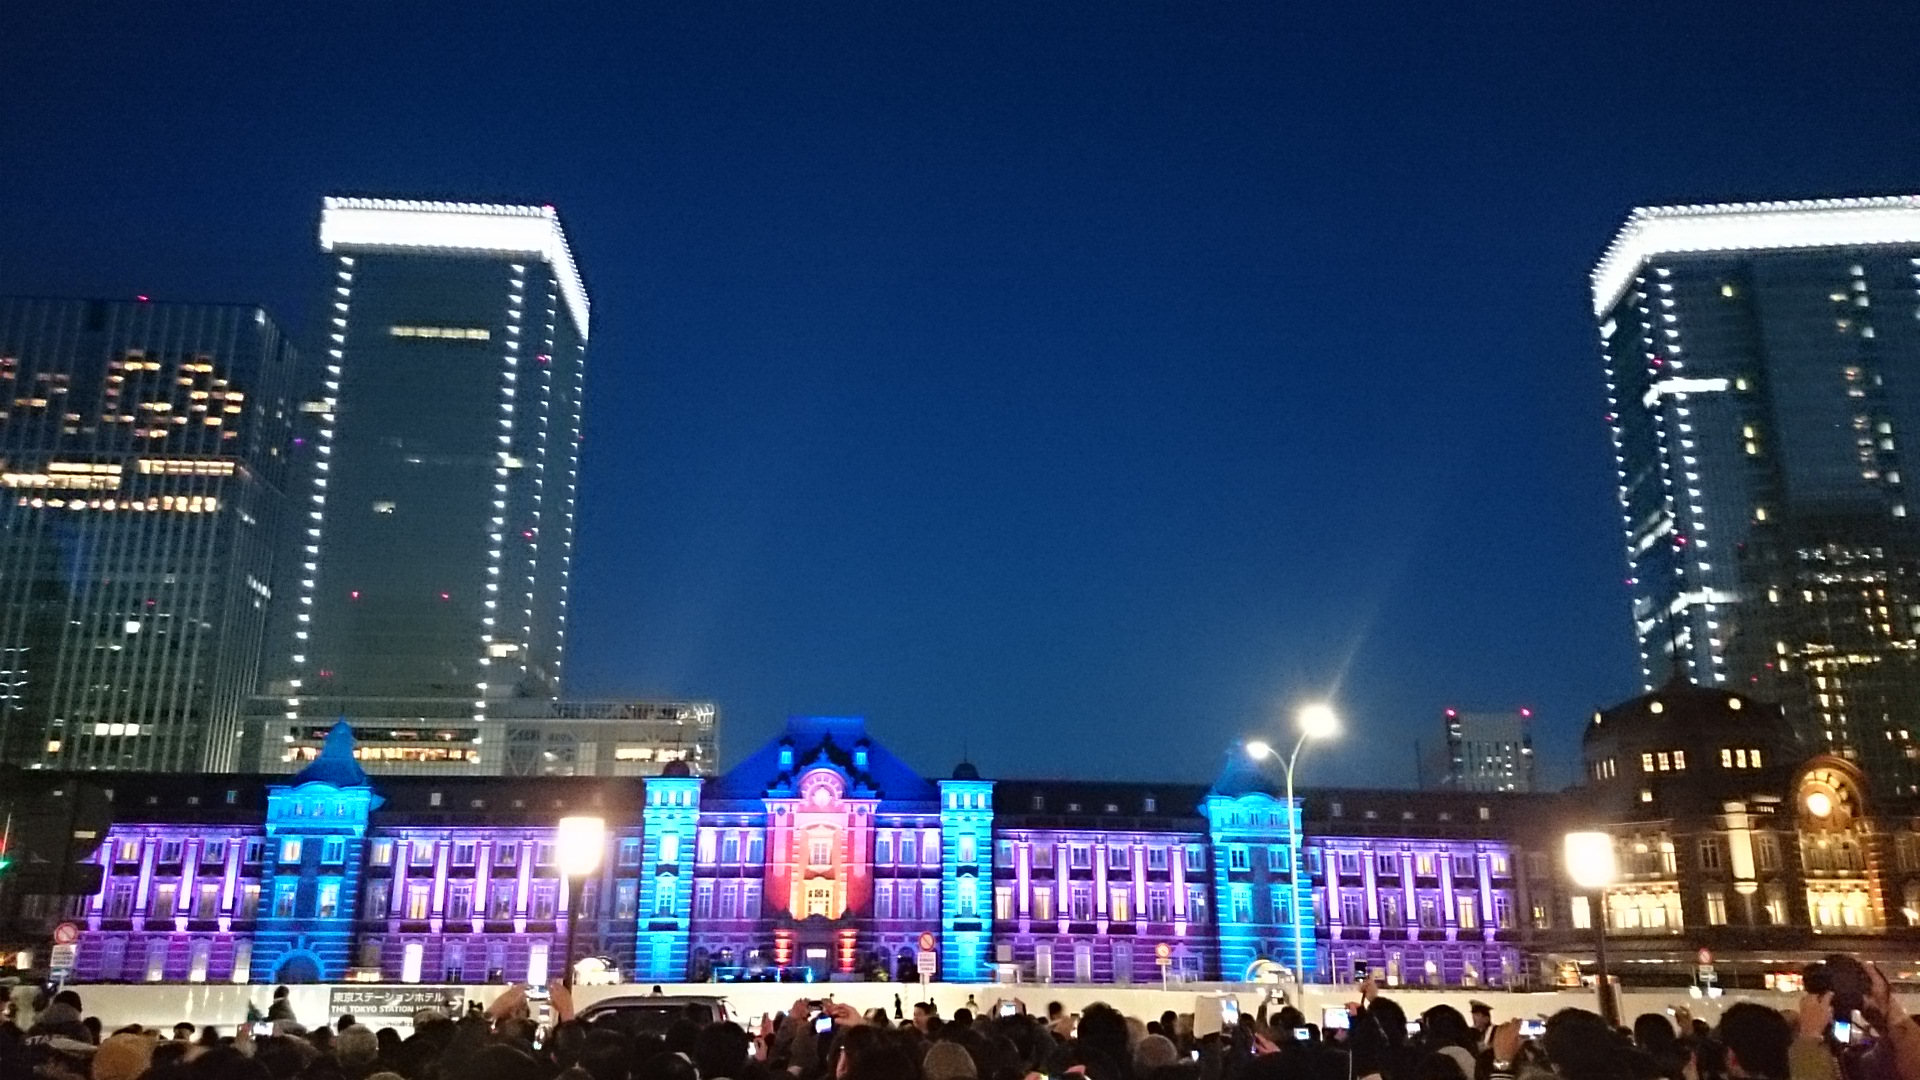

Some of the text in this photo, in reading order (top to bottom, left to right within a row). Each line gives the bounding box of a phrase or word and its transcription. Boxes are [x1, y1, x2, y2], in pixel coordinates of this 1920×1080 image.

[333, 992, 445, 1003] 東京ステーションホテル
[331, 1005, 348, 1013] THE
[349, 1005, 378, 1013] TOKYO
[379, 1005, 414, 1013] STATION
